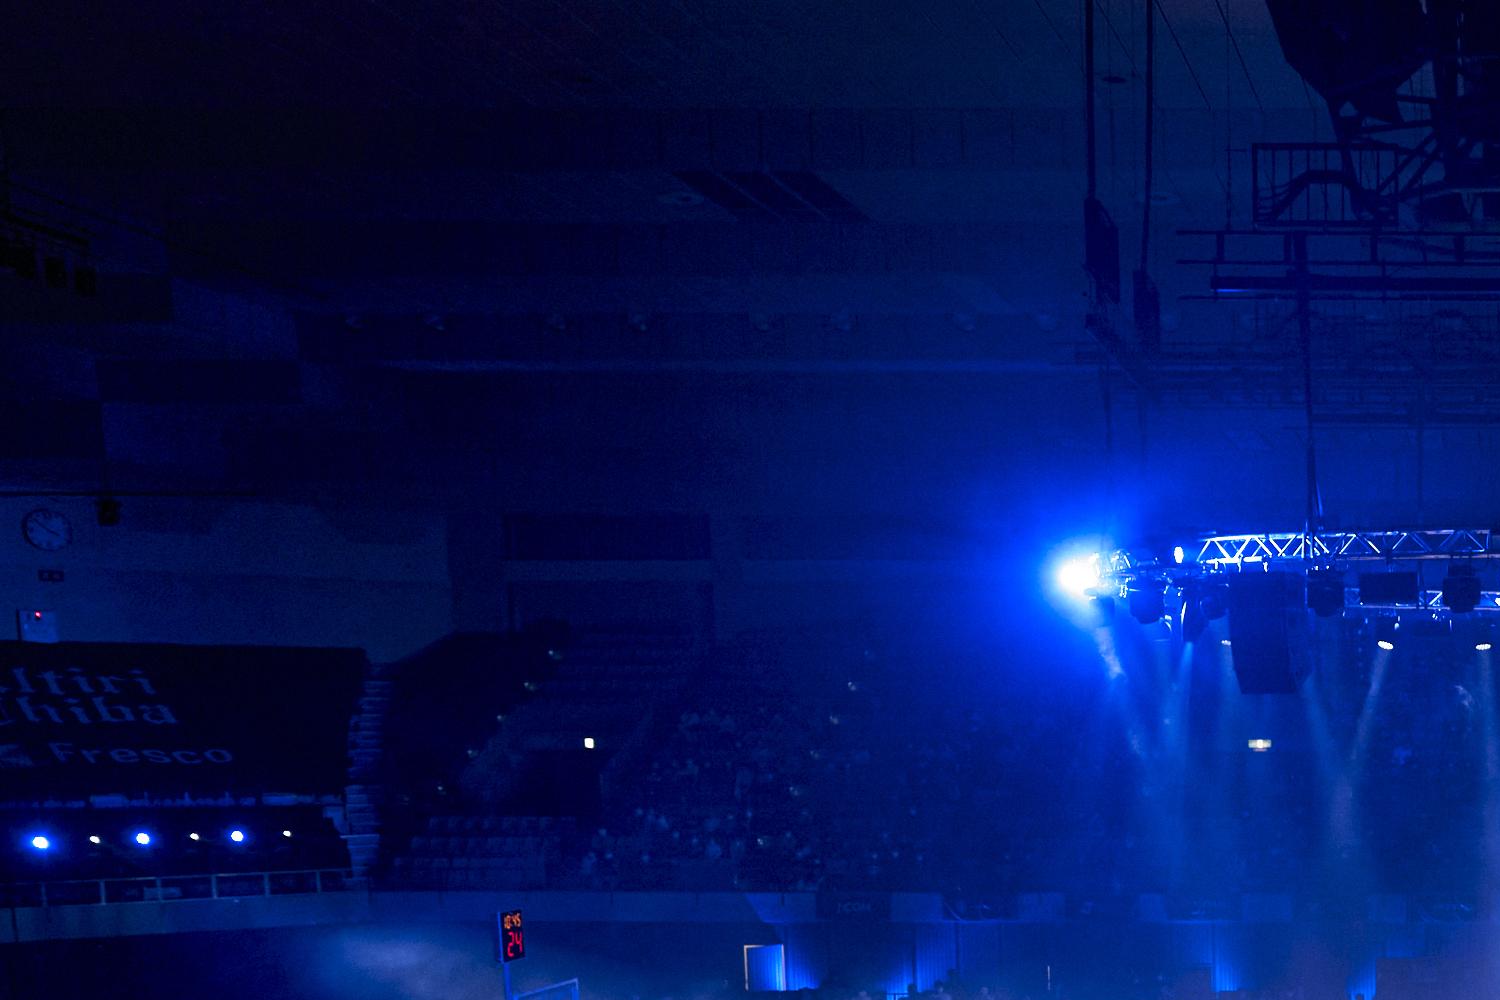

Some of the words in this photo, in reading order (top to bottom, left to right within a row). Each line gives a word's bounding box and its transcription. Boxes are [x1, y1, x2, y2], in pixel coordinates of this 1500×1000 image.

[0, 667, 158, 695] ltiri
[49, 742, 233, 764] Fresco
[507, 931, 523, 957] 24
